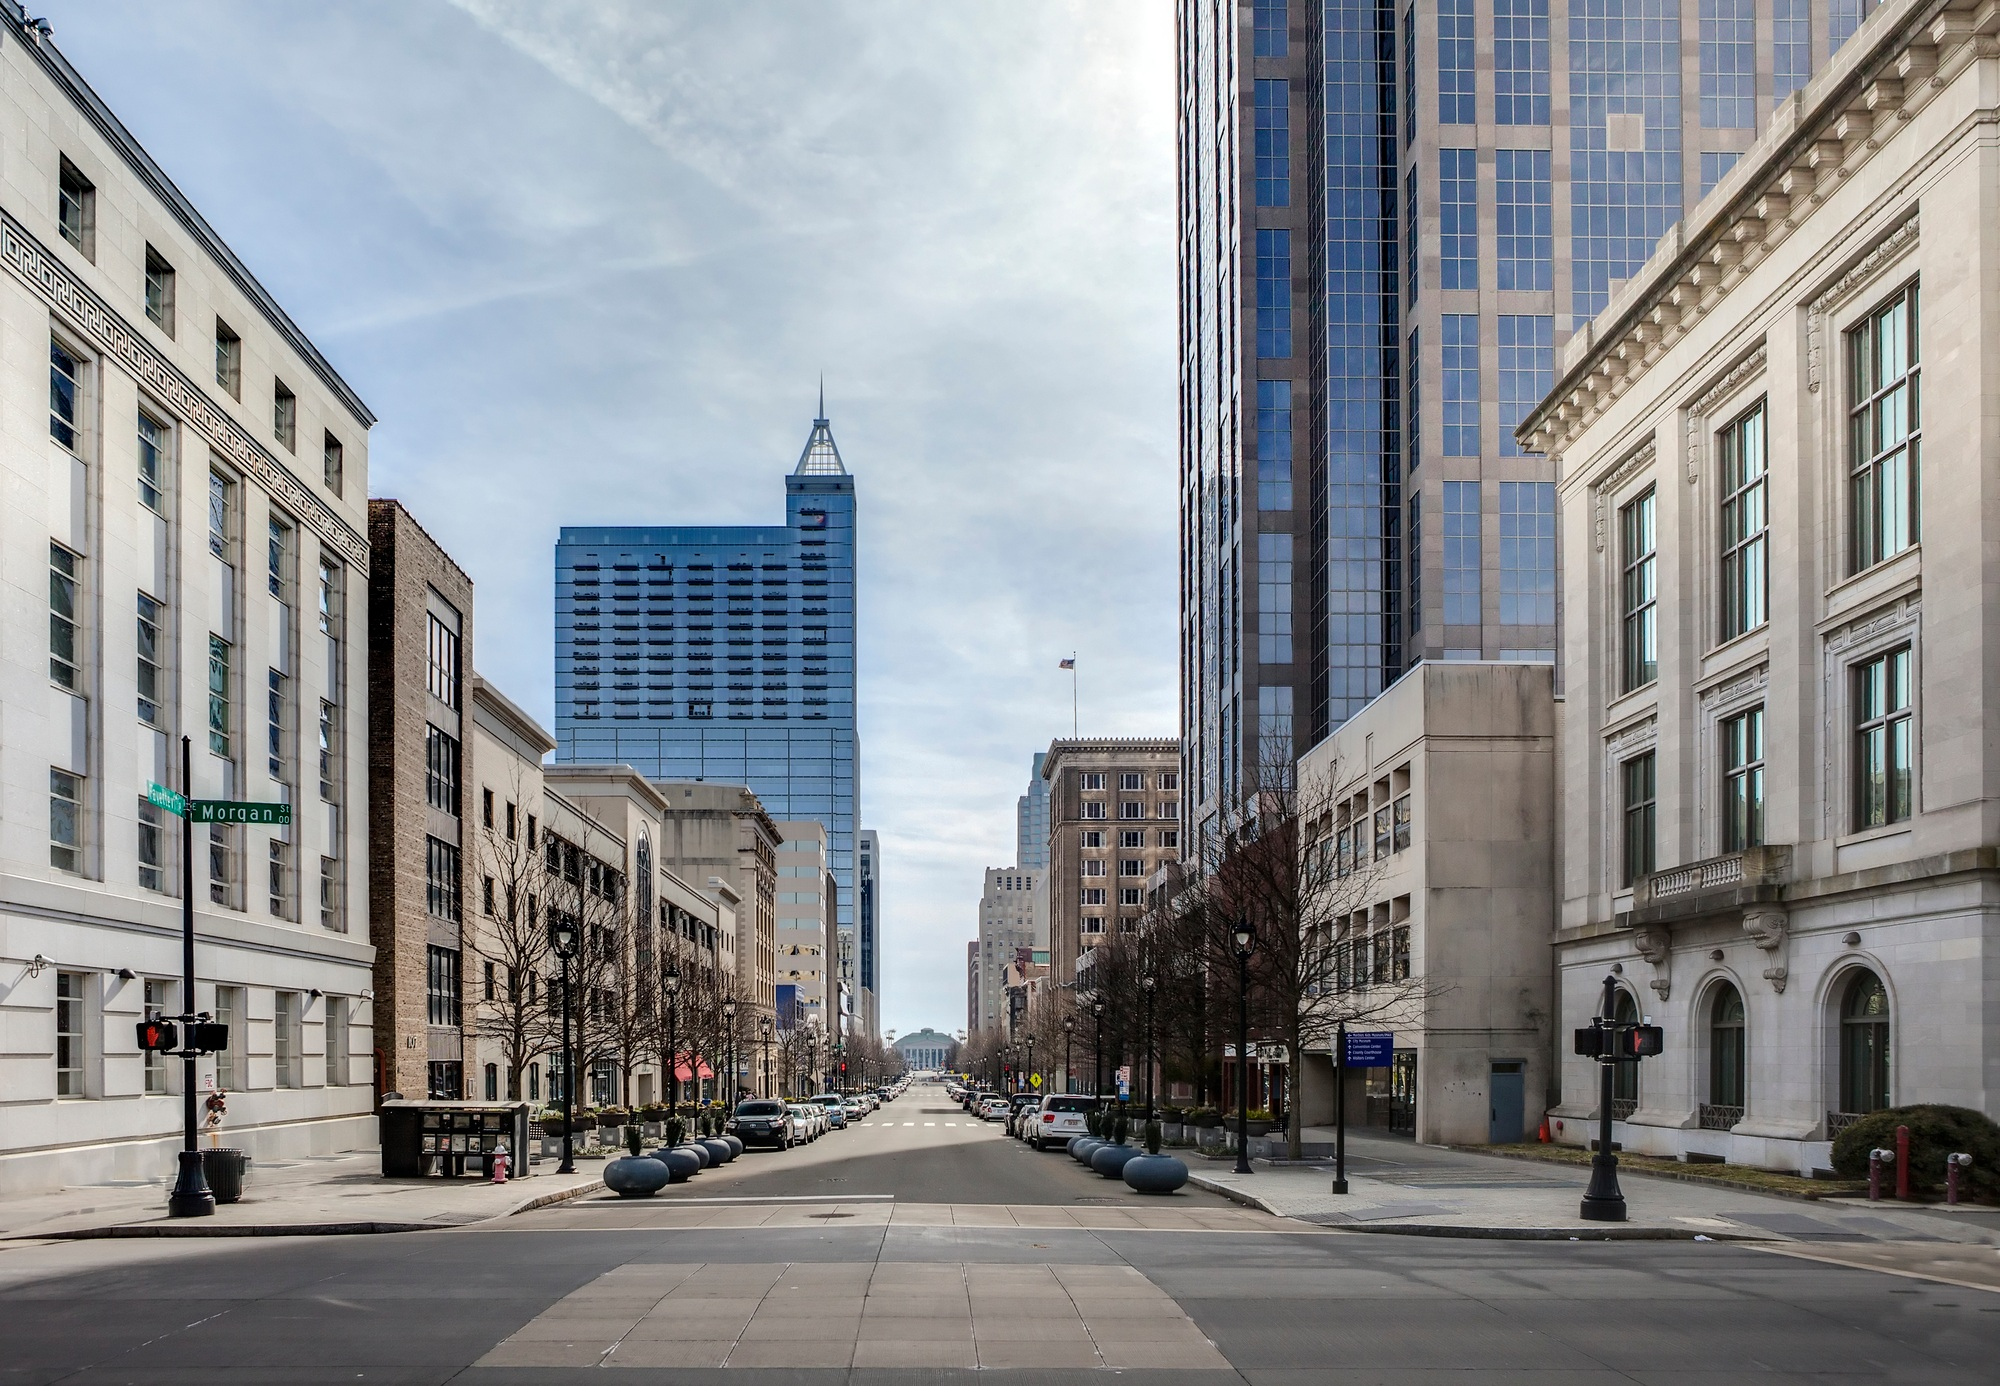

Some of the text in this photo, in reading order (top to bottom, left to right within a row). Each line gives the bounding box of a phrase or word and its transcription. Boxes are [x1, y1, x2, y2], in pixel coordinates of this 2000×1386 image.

[148, 783, 182, 814] Fayetteve
[192, 802, 290, 821] E Morgan St
